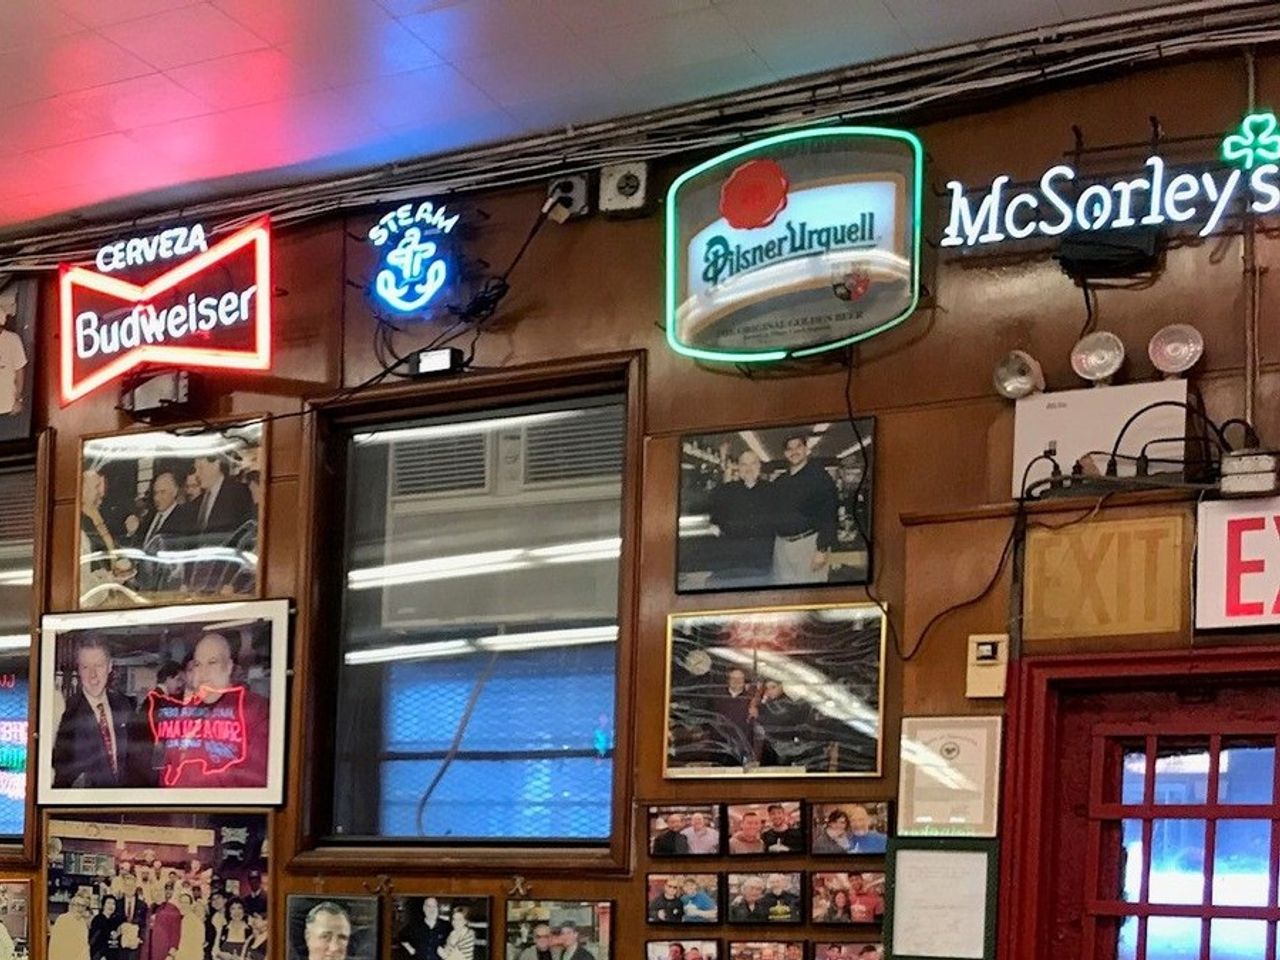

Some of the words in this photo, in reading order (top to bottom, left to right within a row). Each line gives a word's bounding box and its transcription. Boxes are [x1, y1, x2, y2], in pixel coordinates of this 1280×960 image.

[96, 223, 208, 272] CERVEZA
[368, 201, 460, 246] STEAM
[702, 234, 787, 287] Pilsner
[786, 211, 876, 253] Urquell
[75, 285, 258, 359] Budweiser
[1032, 527, 1171, 629] EXIT
